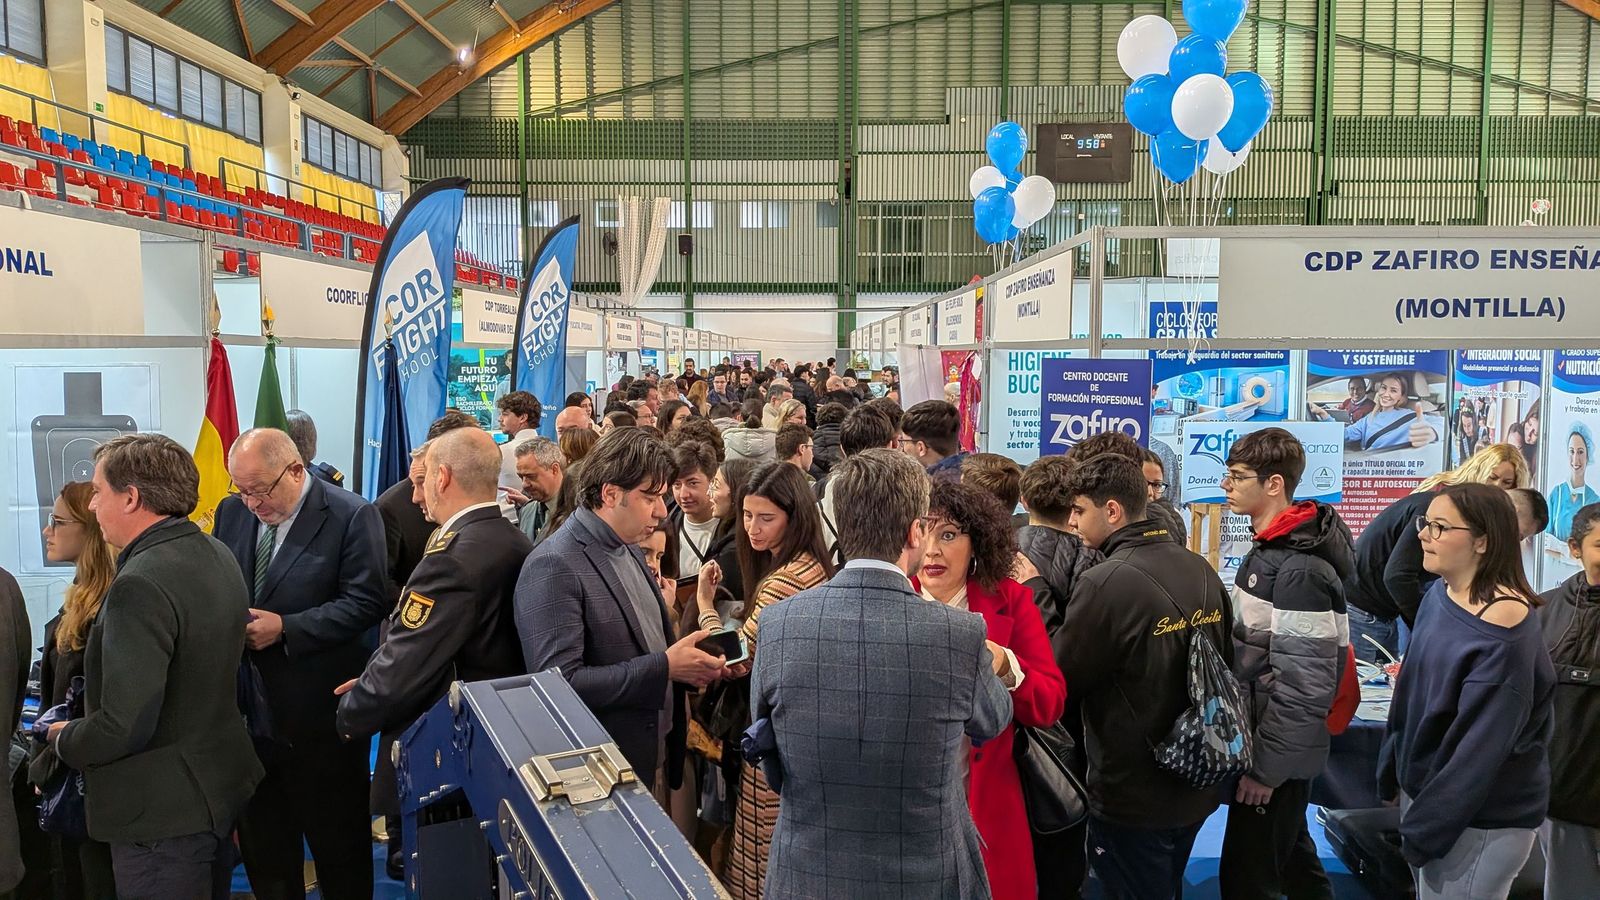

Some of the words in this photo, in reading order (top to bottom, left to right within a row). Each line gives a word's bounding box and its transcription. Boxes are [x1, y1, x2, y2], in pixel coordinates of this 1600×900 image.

[1304, 250, 1363, 272] CDP
[1372, 249, 1480, 271] ZAFIRO
[1490, 245, 1600, 270] ENSEÑA
[385, 268, 440, 327] COR
[531, 281, 566, 322] COR
[485, 300, 494, 311] CDP
[1394, 297, 1566, 323] (MONTILLA)
[1156, 312, 1192, 328] CICLOS
[1221, 350, 1230, 359] del
[1231, 351, 1252, 360] sector
[1254, 350, 1284, 360] sanitario
[1342, 354, 1350, 365] Y
[1353, 354, 1415, 366] SOSTENIBLE
[1515, 350, 1541, 361] SOCIAL
[485, 357, 497, 365] TU
[461, 367, 498, 375] FUTURO
[1462, 364, 1488, 372] Modalidades
[1488, 365, 1510, 373] presencial
[1518, 365, 1540, 373] distancia
[457, 375, 498, 384] EMPIEZA
[1063, 371, 1092, 382] CENTRO
[1093, 372, 1129, 382] DOCENTE
[1090, 383, 1099, 392] DE
[1048, 393, 1090, 404] FORMACIÓN
[1091, 395, 1144, 406] PROFESIONAL
[1565, 405, 1569, 413] y
[1569, 405, 1590, 414] trabaja
[1012, 418, 1021, 428] tu
[1050, 410, 1142, 444] zafiro
[1009, 431, 1015, 440] y
[1006, 440, 1034, 449] sector
[1364, 459, 1385, 467] TÍTULO
[1386, 469, 1406, 477] ejercer
[1188, 475, 1219, 485] Donde
[1153, 616, 1187, 636] Santa
[1190, 608, 1222, 627] Cecilia
